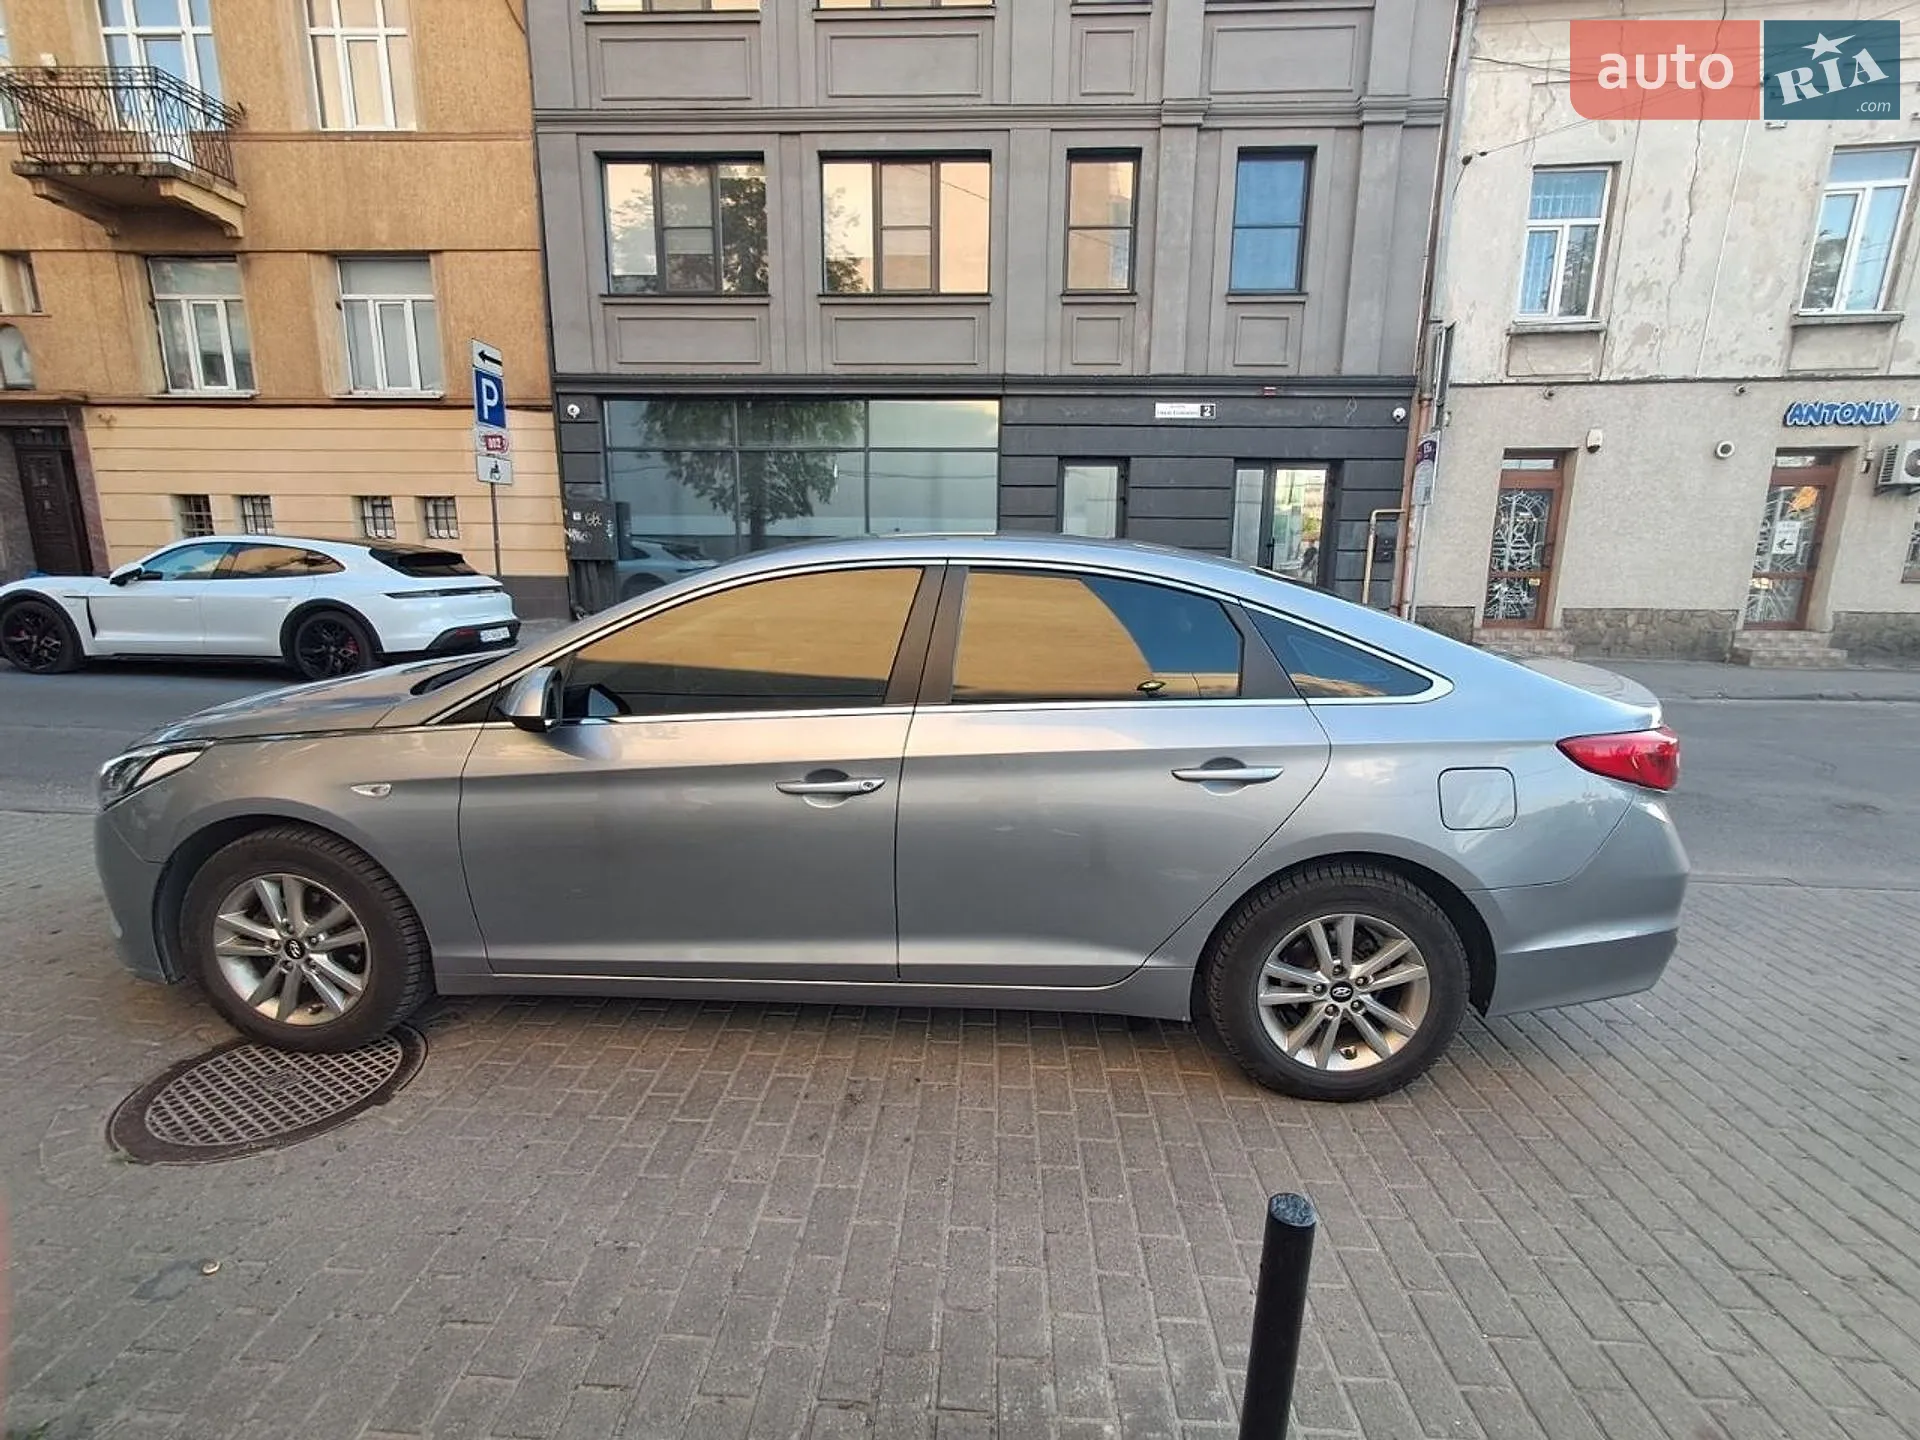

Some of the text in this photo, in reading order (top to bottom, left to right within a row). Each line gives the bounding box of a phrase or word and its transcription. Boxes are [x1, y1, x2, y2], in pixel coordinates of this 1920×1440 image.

[481, 378, 499, 420] P
[1203, 405, 1212, 417] 2
[1785, 400, 1902, 426] ANTONIV
